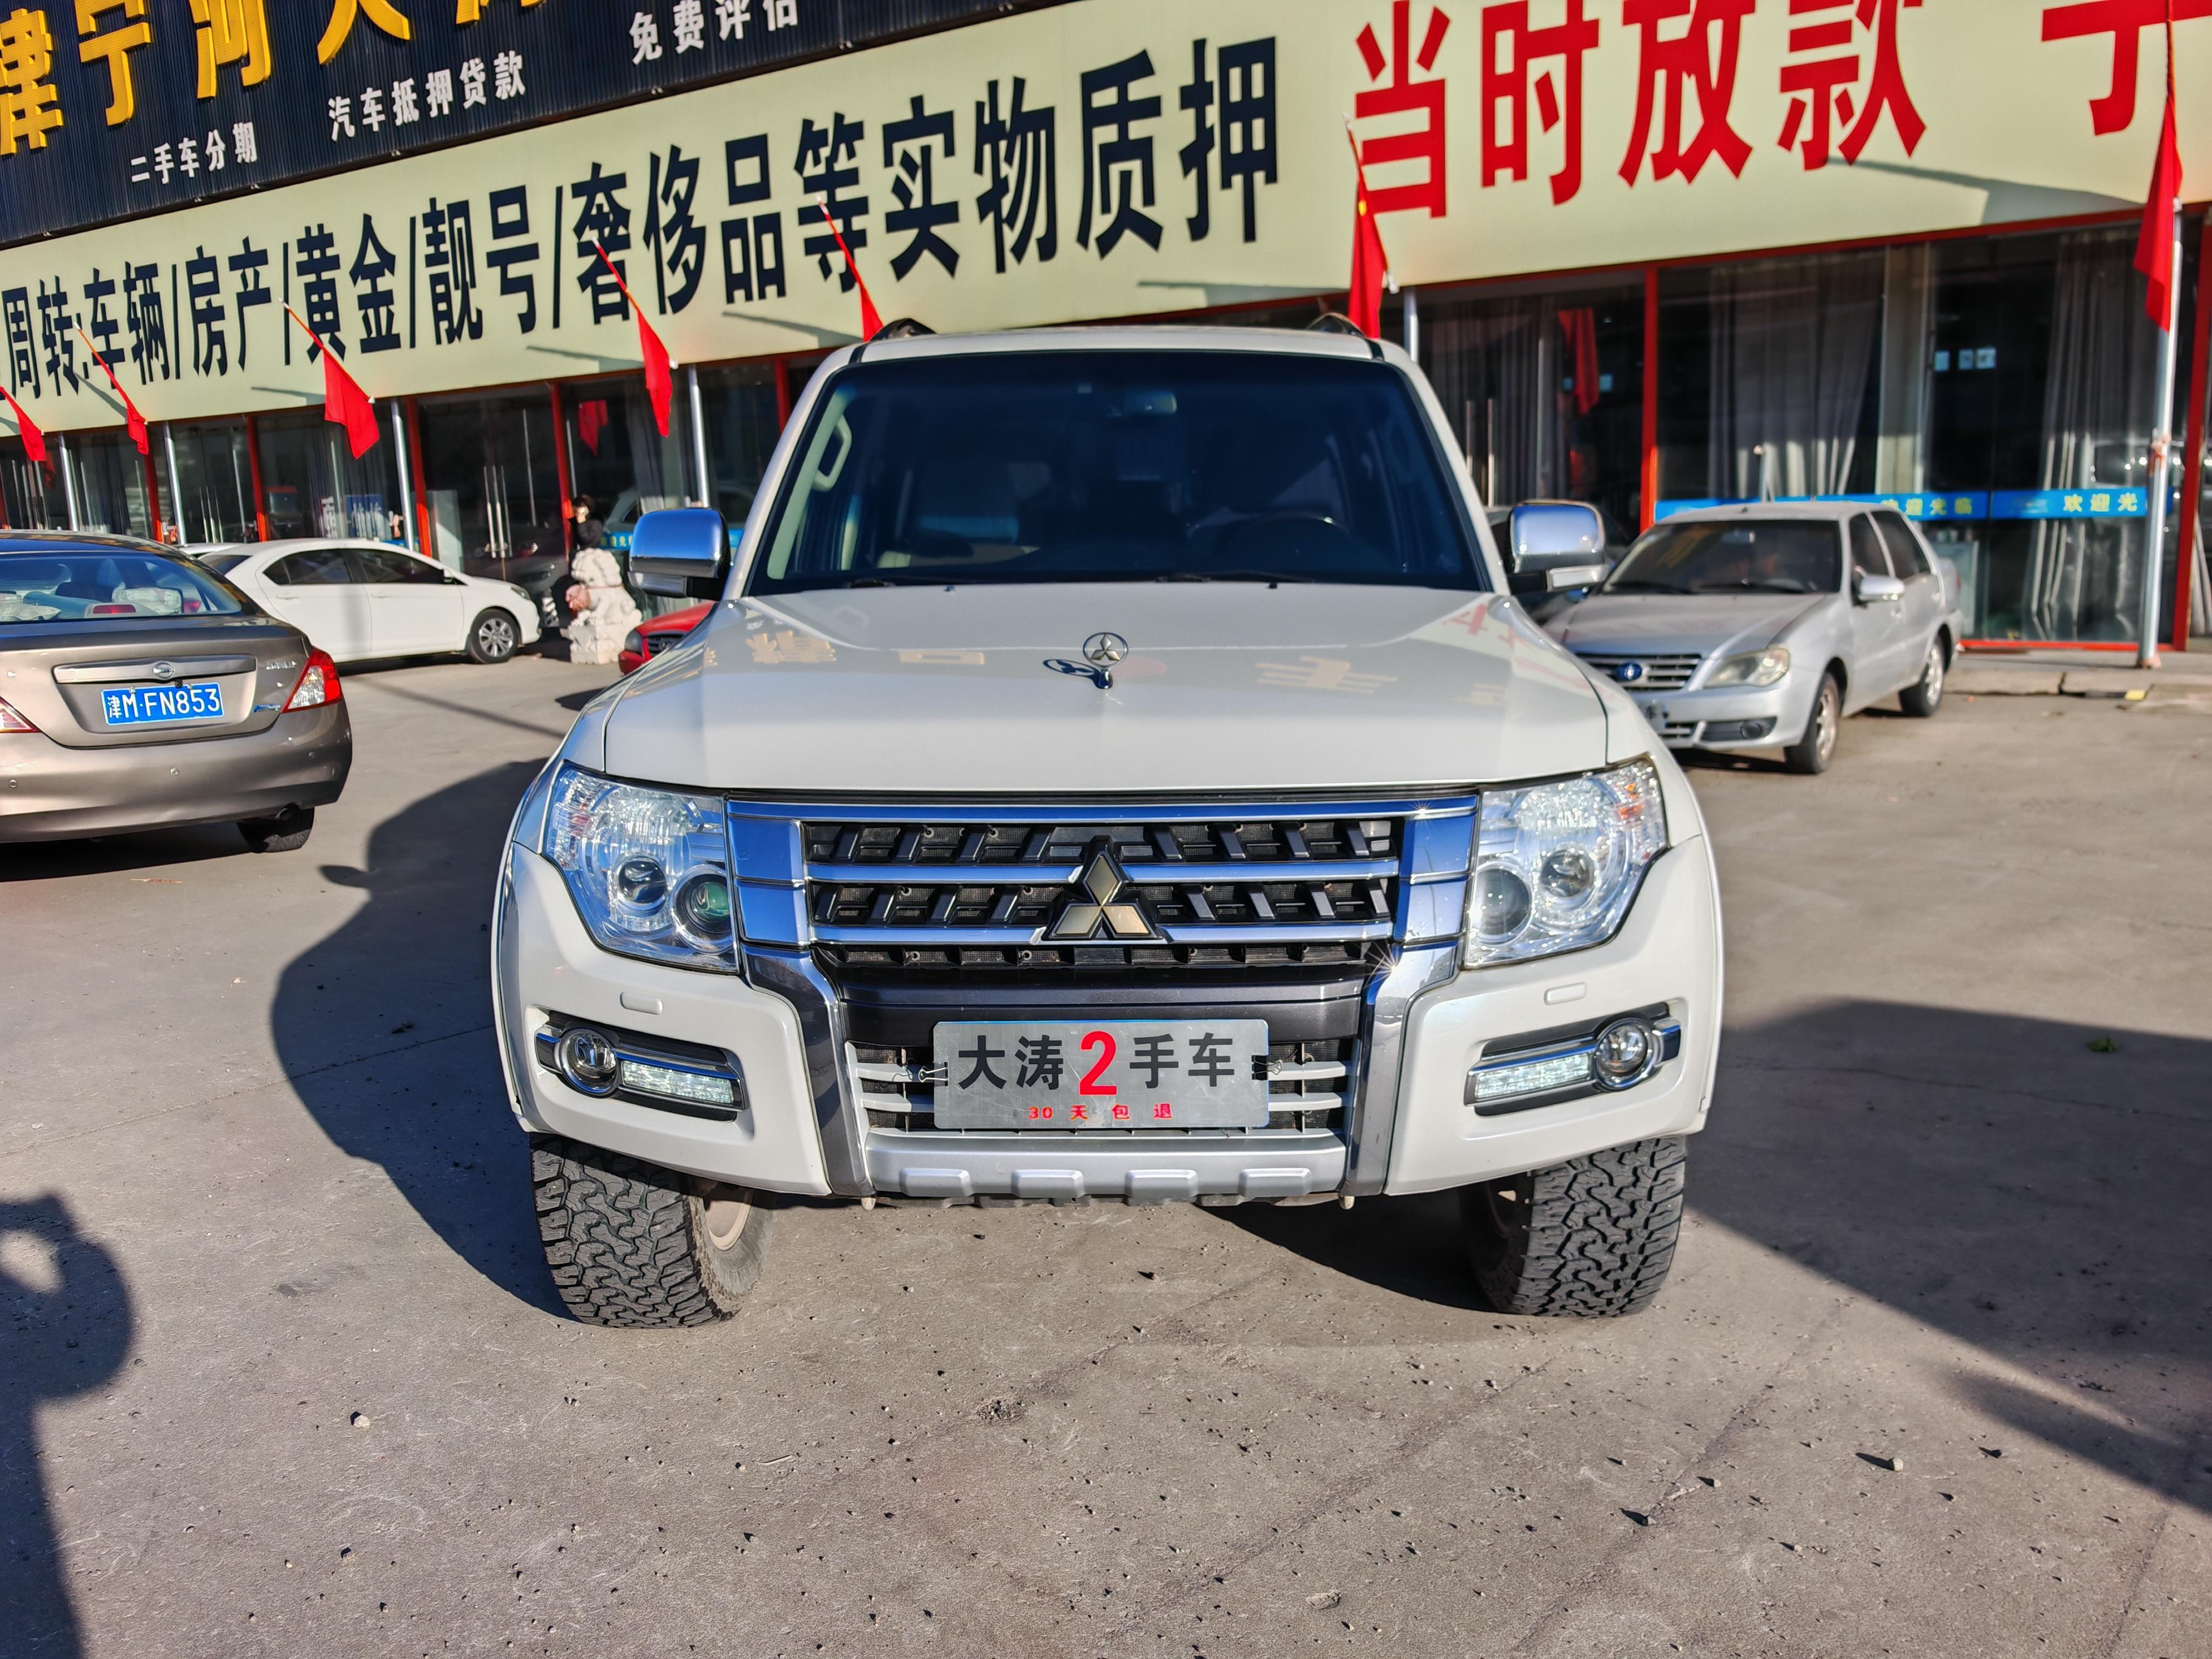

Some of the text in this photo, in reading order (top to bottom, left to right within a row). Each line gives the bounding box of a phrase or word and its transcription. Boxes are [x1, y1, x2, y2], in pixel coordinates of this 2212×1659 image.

[328, 50, 525, 141] 汽车抵押贷款
[1355, 0, 1926, 219] 当时放款
[131, 122, 258, 184] 二手车分期
[958, 1030, 1235, 1096] 大涛2手车
[1028, 1103, 1172, 1121] 30天包退
